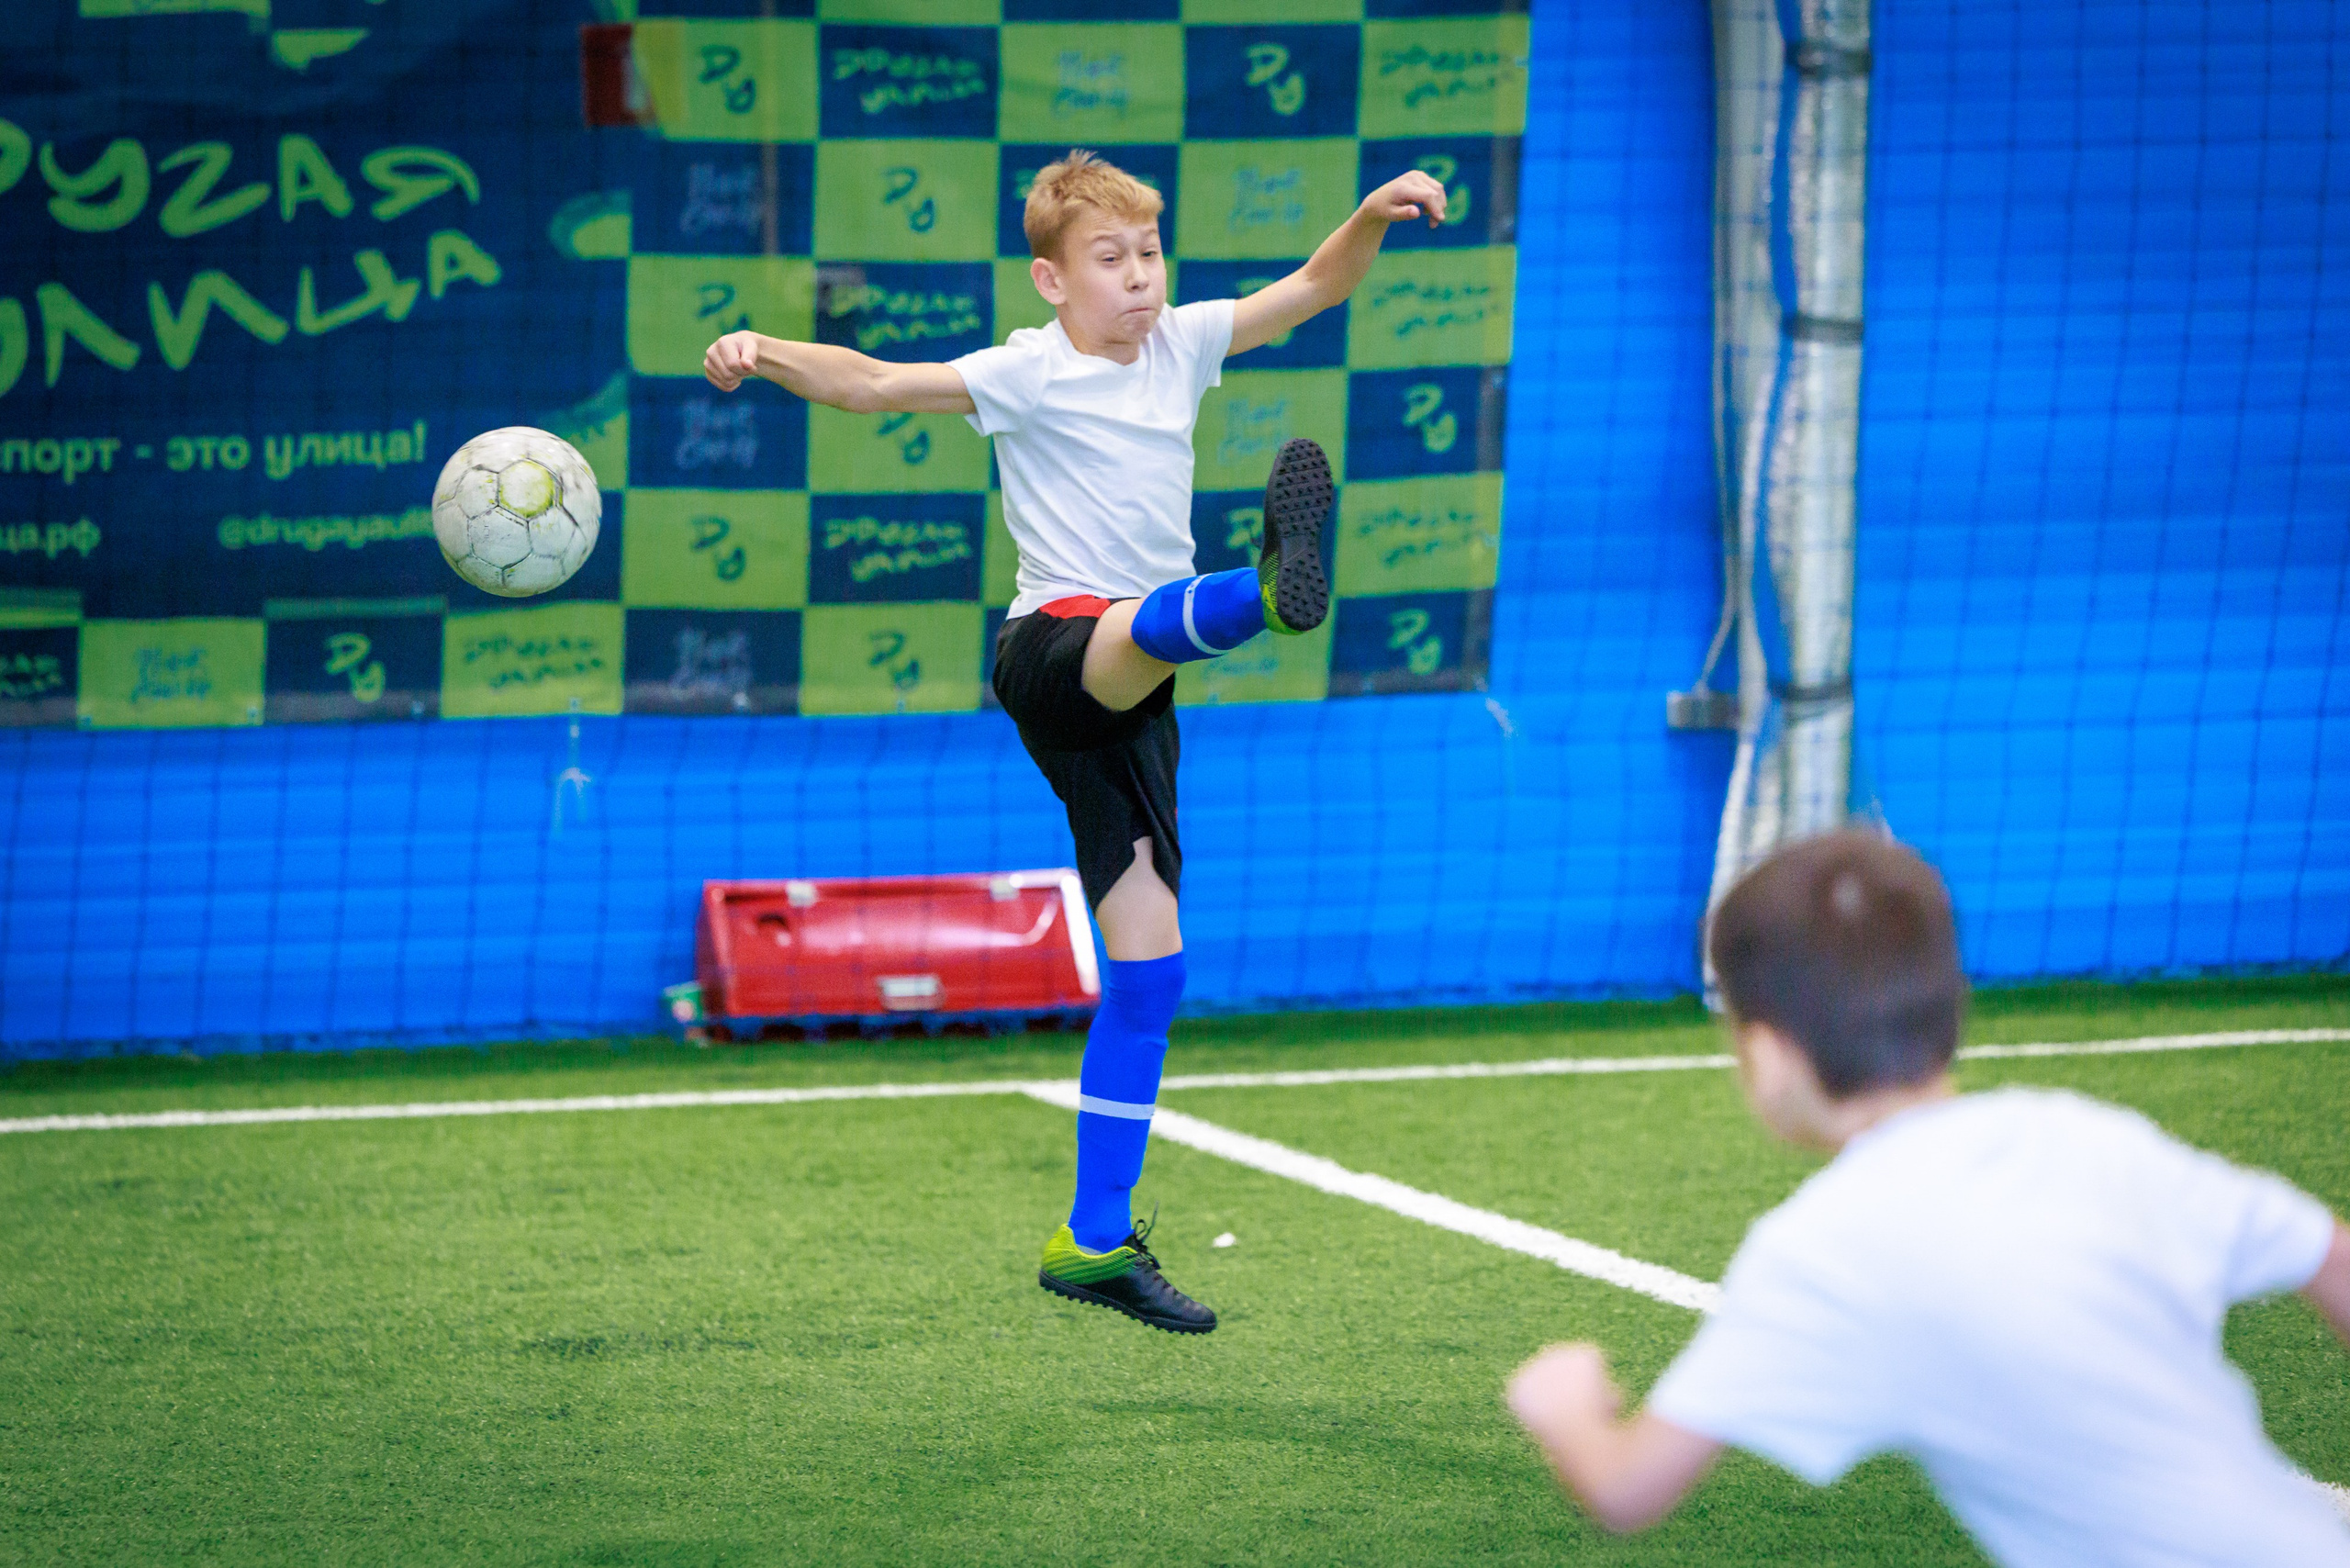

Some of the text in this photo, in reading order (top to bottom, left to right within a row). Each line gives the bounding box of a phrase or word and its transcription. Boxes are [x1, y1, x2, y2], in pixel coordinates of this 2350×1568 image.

[0, 229, 502, 398] ЛИЦА
[166, 435, 251, 471] это
[263, 419, 427, 480] улица!
